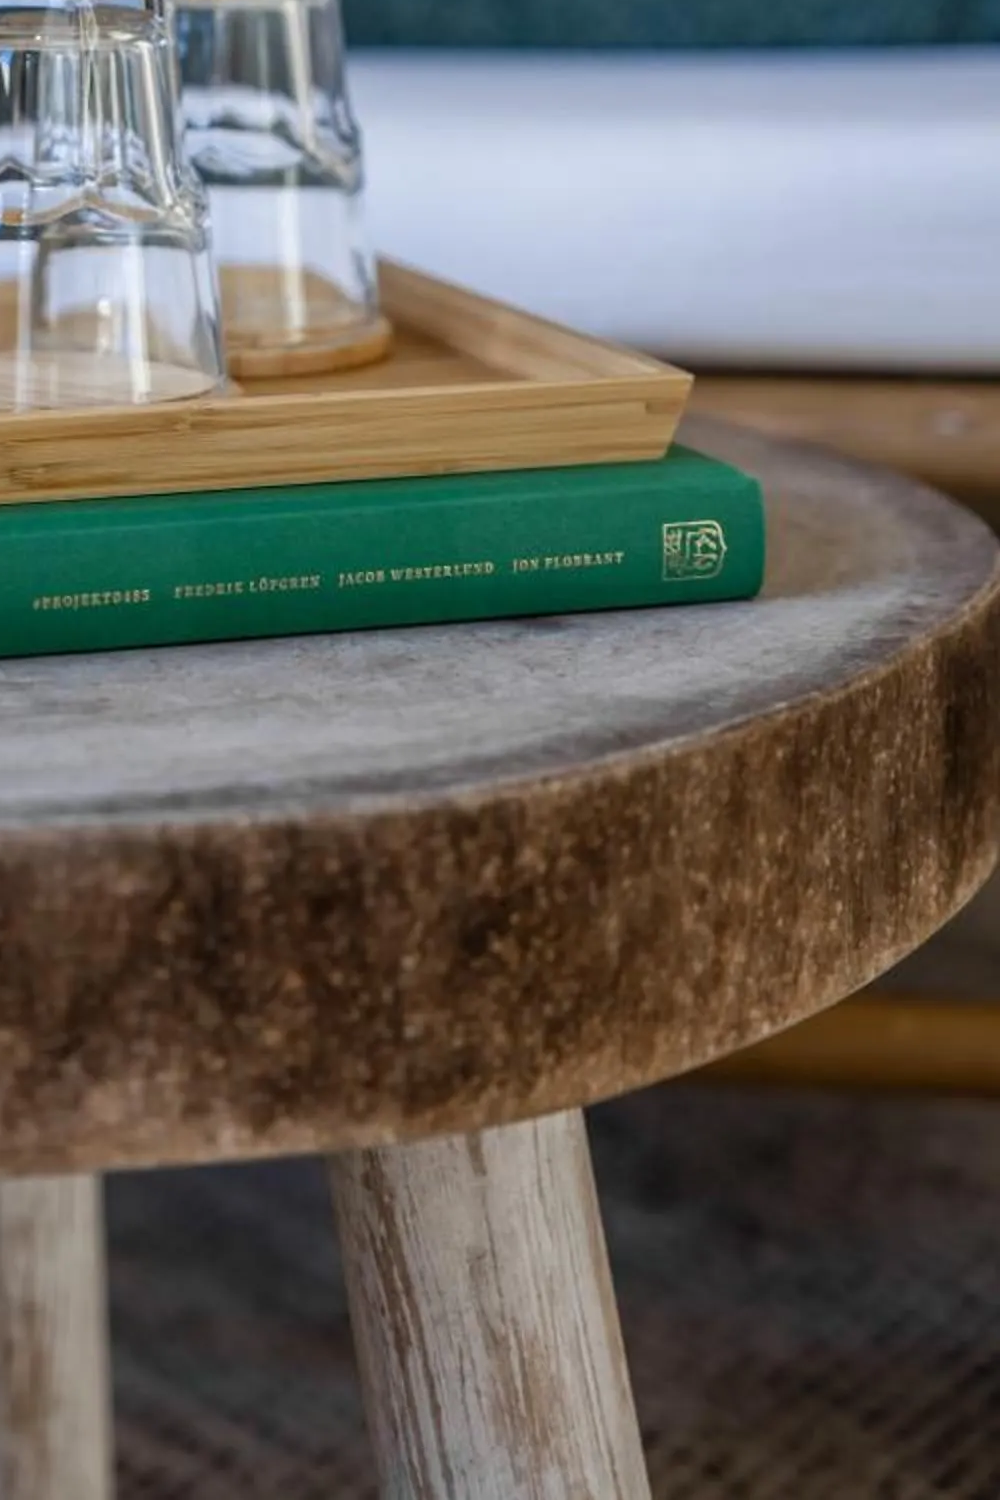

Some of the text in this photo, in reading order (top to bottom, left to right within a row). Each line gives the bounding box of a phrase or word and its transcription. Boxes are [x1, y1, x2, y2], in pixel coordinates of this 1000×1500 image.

[338, 560, 495, 589] JACOB WESTERLUND
[512, 557, 540, 575] JON
